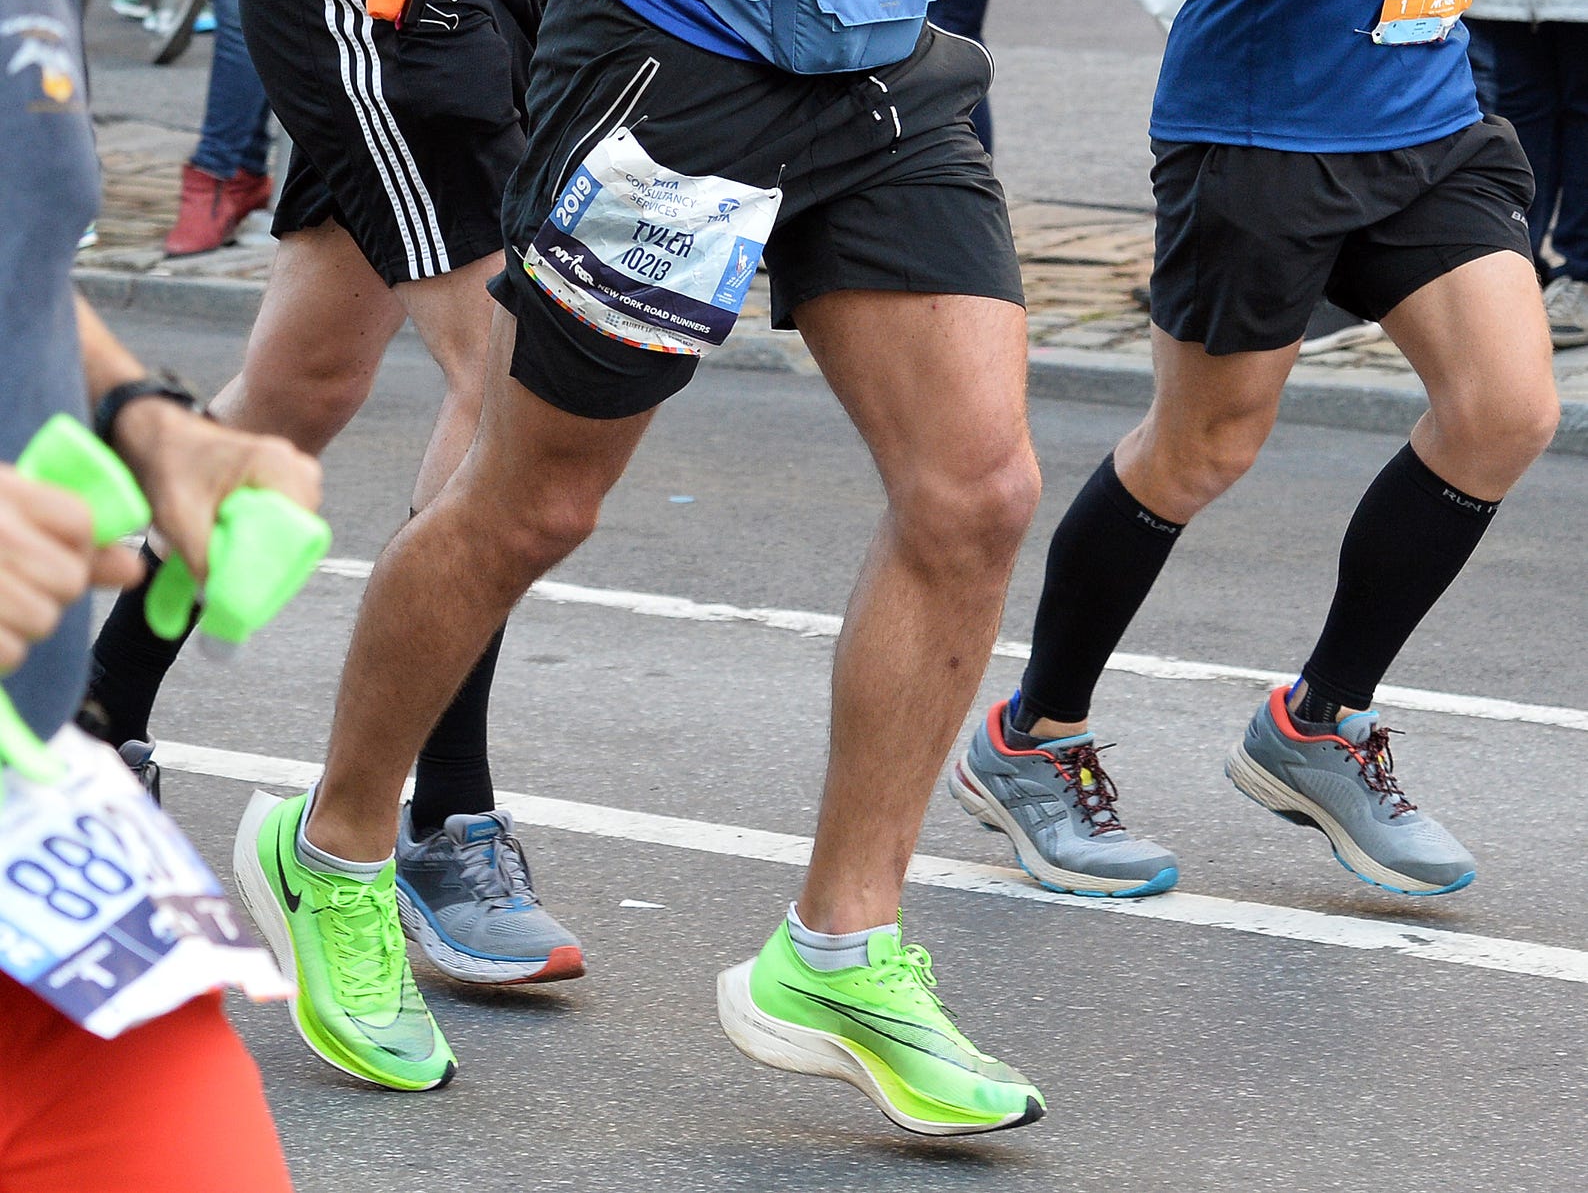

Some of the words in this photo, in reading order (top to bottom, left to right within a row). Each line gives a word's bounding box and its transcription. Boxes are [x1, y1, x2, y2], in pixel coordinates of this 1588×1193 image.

[555, 175, 592, 227] 2019
[625, 173, 697, 208] CONSULTANCY
[630, 193, 679, 218] SERVICES
[707, 214, 730, 224] TATA
[632, 219, 694, 258] TYLER
[621, 247, 672, 281] 10213
[597, 284, 619, 299] NEW
[643, 304, 670, 320] ROAD
[669, 314, 712, 334] RUNNERS
[1442, 489, 1482, 512] RUN
[1137, 511, 1176, 534] RUN
